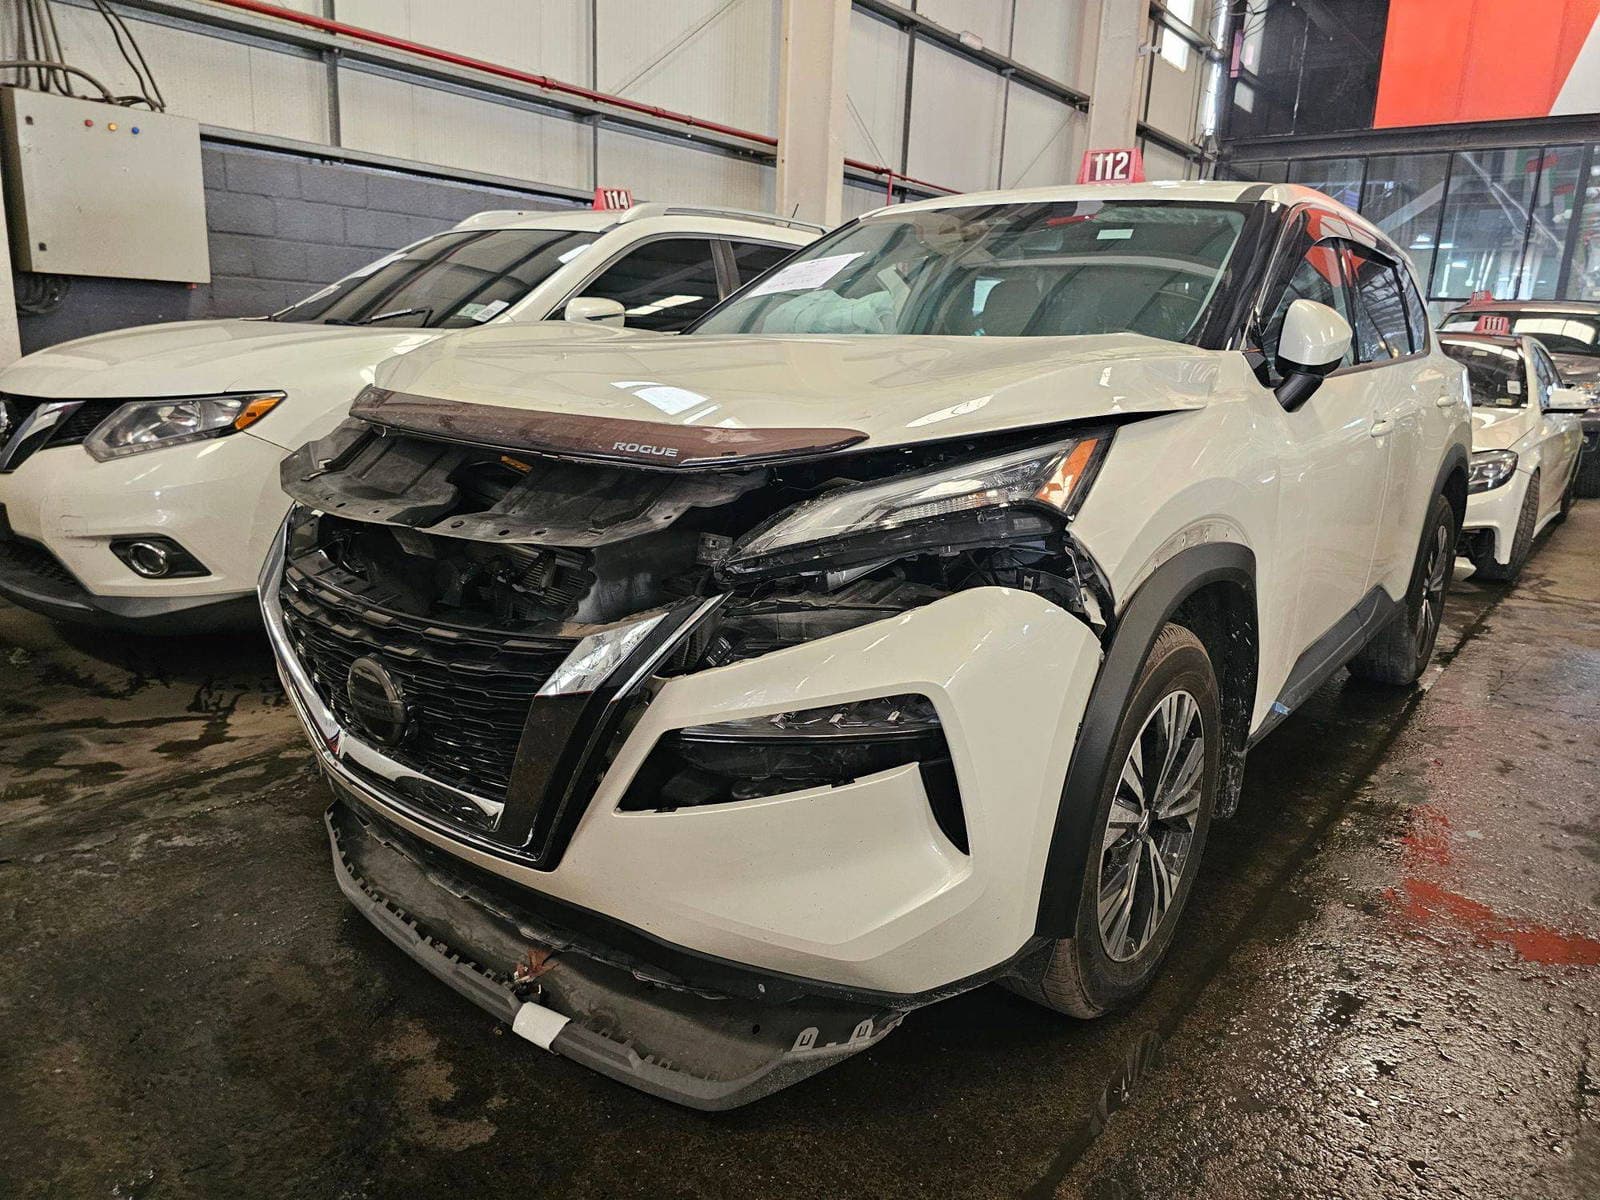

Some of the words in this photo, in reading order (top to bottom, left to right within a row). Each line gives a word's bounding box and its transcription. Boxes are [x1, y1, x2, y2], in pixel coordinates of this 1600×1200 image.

[1095, 151, 1129, 180] 112
[605, 190, 629, 209] 114
[1486, 317, 1504, 330] 111
[612, 441, 679, 457] ROGUE
